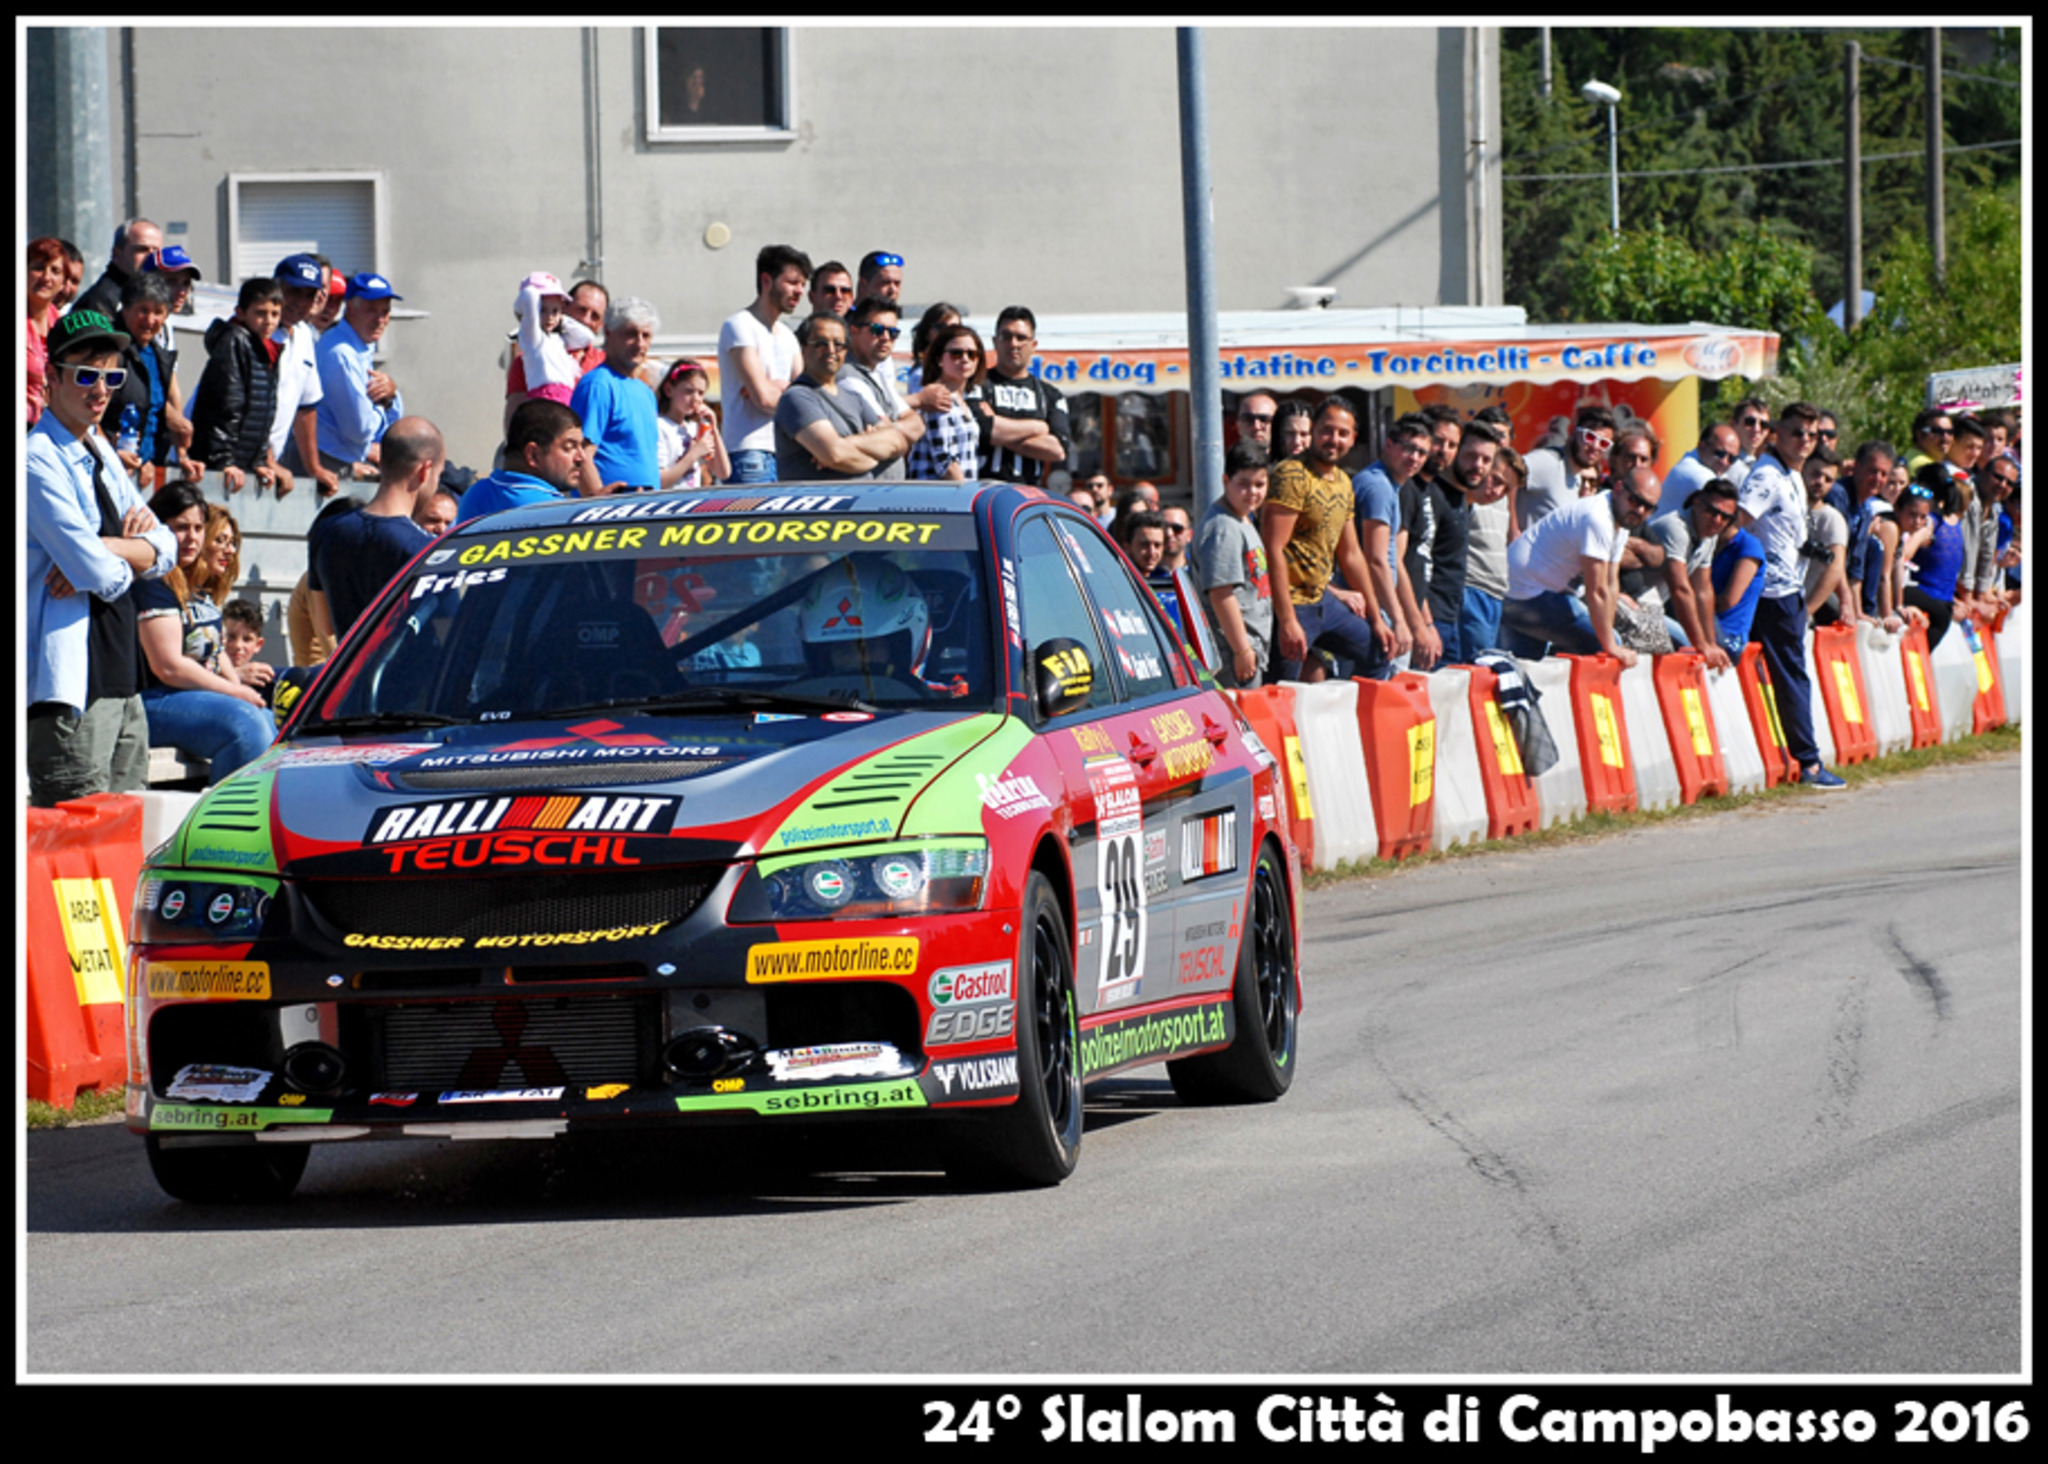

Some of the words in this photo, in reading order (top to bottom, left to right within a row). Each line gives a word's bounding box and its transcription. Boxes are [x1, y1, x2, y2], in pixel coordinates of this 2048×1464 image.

[1089, 356, 1156, 385] dog
[1218, 353, 1336, 379] atatine
[1367, 347, 1530, 375] Torcinelli
[1561, 340, 1657, 369] Caffè
[458, 527, 648, 565] GASSNER
[659, 520, 941, 547] MOTORSPORT
[410, 567, 508, 600] Fries
[480, 711, 511, 721] EVO
[420, 748, 584, 768] MITSUBISHI
[597, 745, 720, 757] MOTORS
[371, 797, 512, 842] RALLI
[565, 796, 672, 831] ART
[382, 835, 641, 873] TEUSCHL
[70, 899, 100, 923] AREA
[1105, 834, 1139, 983] 29
[343, 933, 465, 950] GASSNER
[474, 921, 671, 948] MOTORSPORT
[754, 941, 914, 977] www.motorline.cc
[149, 965, 265, 994] www.motorline.cc
[954, 967, 1007, 1001] Castrol
[926, 1003, 1015, 1046] EDGE
[1080, 1003, 1227, 1077] polizeimotorsport.at
[712, 1077, 746, 1092] OMP
[957, 1056, 1019, 1091] VOLKSBANK
[766, 1084, 914, 1110] sebring.at
[154, 1107, 260, 1127] sebring.at
